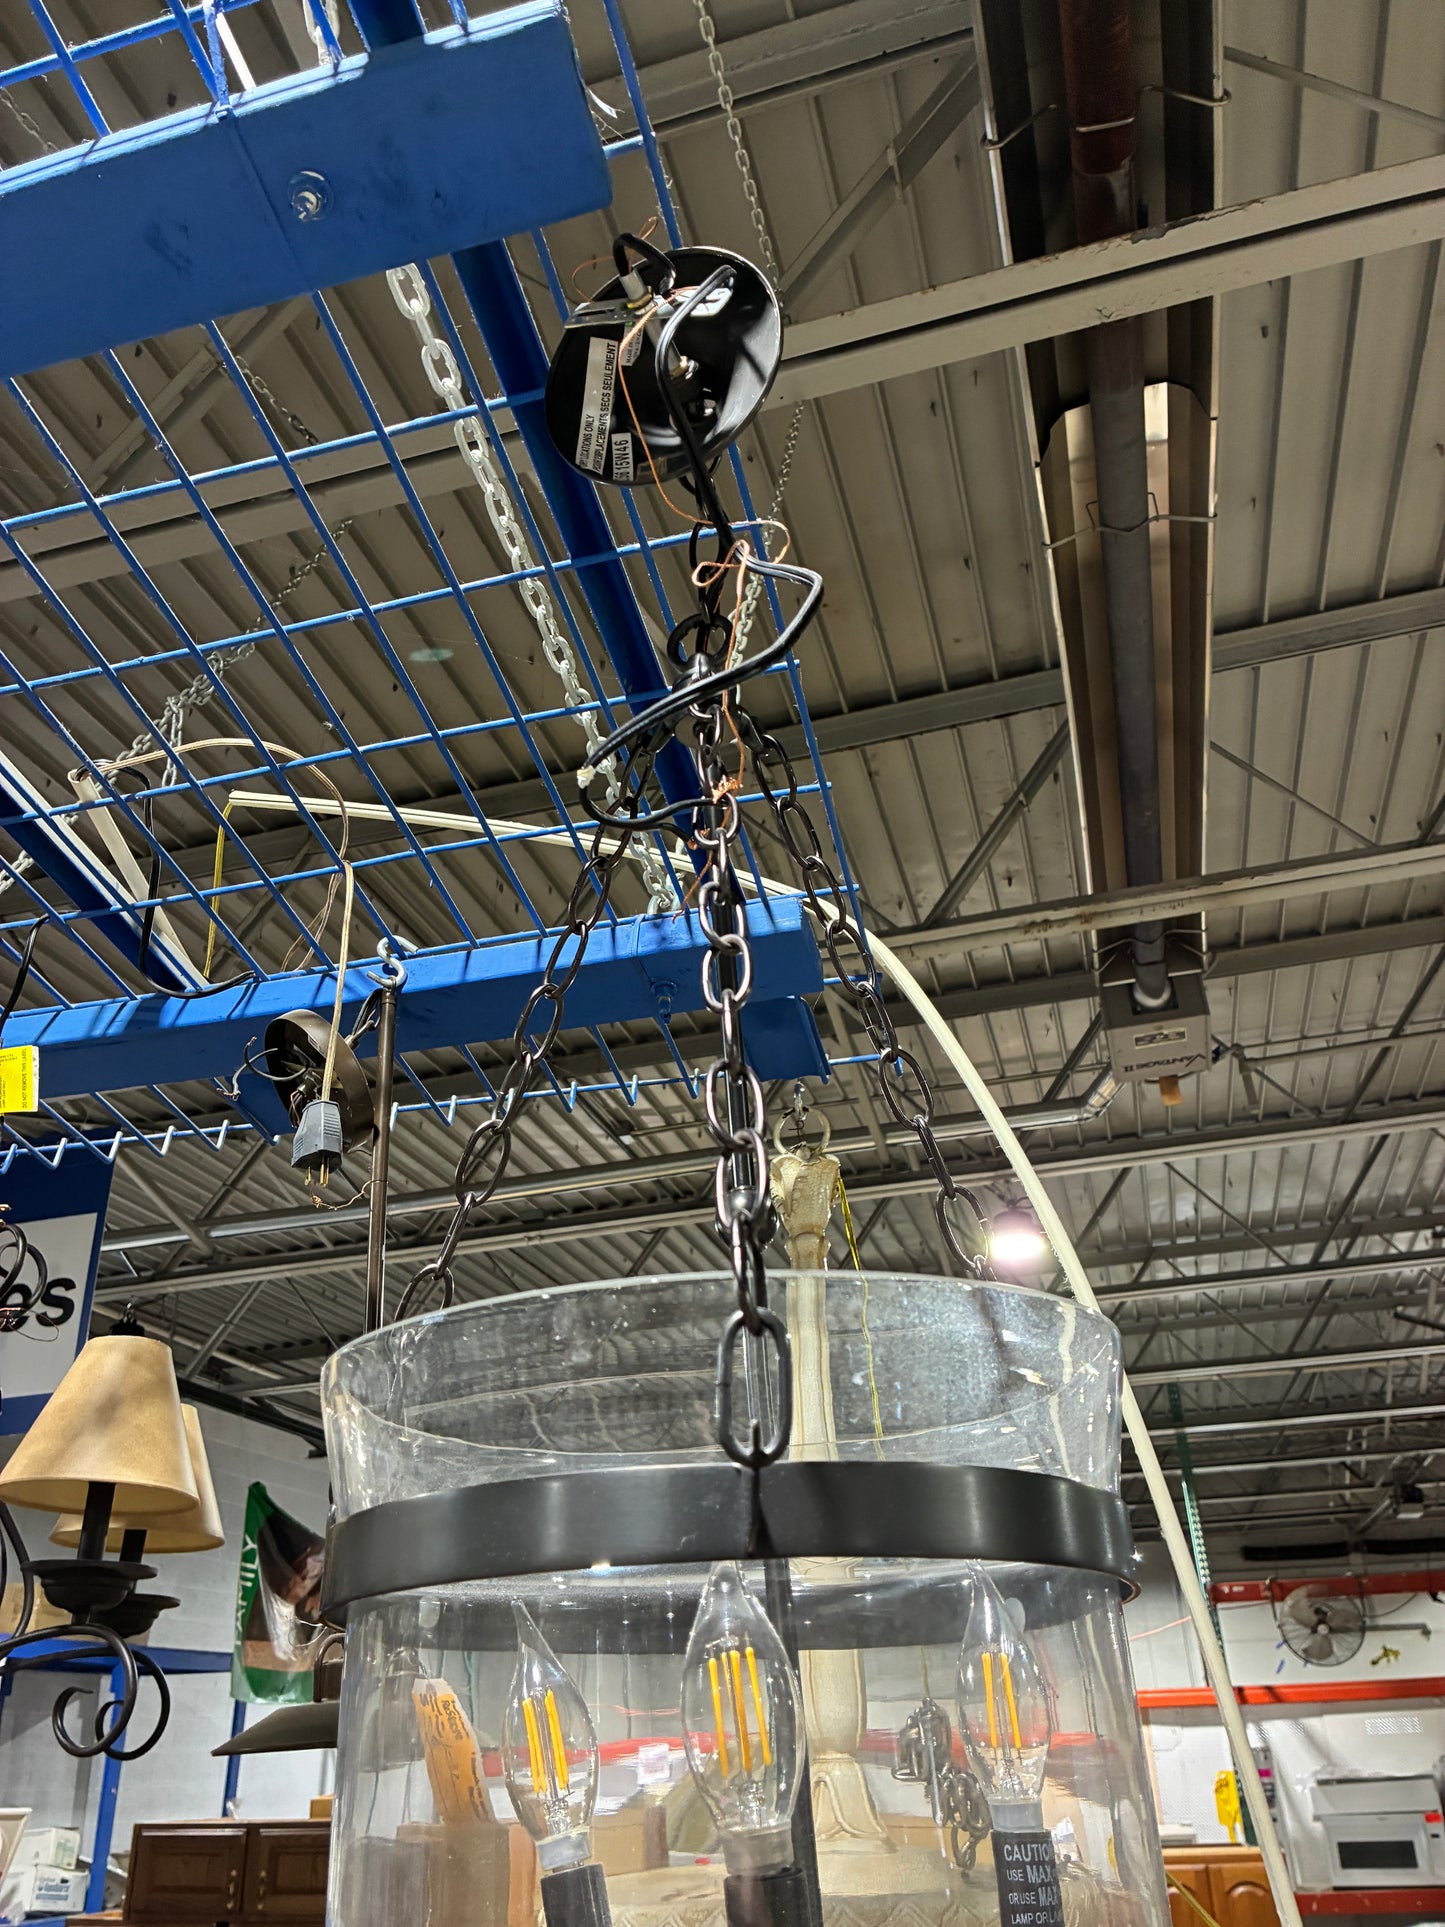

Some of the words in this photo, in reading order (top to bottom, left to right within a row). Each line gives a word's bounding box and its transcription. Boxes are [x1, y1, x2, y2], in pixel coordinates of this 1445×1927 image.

[602, 342, 617, 392] SEULEMENT
[599, 392, 611, 413] SECS
[585, 414, 595, 434] ONLY
[1006, 1869, 1025, 1882] USE
[1008, 1893, 1019, 1905] OR
[1020, 1891, 1037, 1905] USE
[1011, 1912, 1034, 1925] LAMP
[1035, 1911, 1048, 1924] OR
